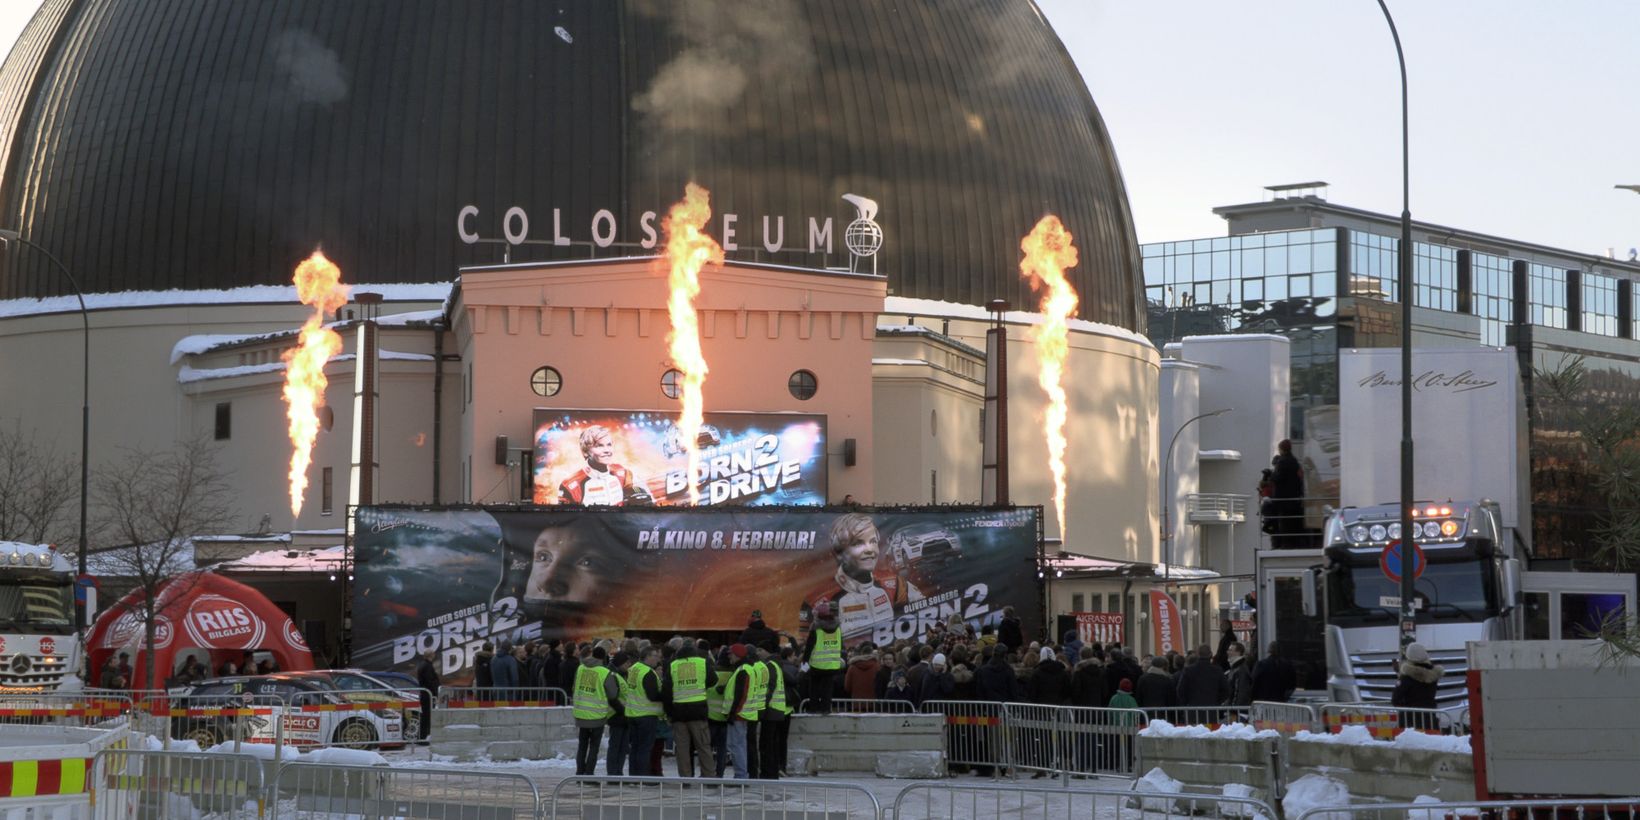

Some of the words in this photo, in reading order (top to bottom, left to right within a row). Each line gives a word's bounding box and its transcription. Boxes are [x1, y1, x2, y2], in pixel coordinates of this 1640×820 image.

[457, 205, 833, 254] COLOSEUM
[754, 434, 780, 469] 2
[710, 459, 801, 505] DRIVE
[637, 526, 660, 550] PÅ
[664, 530, 707, 550] KINO
[711, 530, 727, 550] 8.
[732, 530, 816, 550] FEBRUAR!
[427, 613, 453, 628] OLIVER
[453, 602, 487, 619] SOLBERG
[903, 600, 928, 614] OLIVER
[928, 589, 959, 606] SOLBERG
[964, 583, 989, 619] 2
[195, 607, 250, 632] RIIS
[208, 626, 252, 640] BILGLASS
[393, 611, 489, 664] BORN
[492, 596, 519, 634] 2
